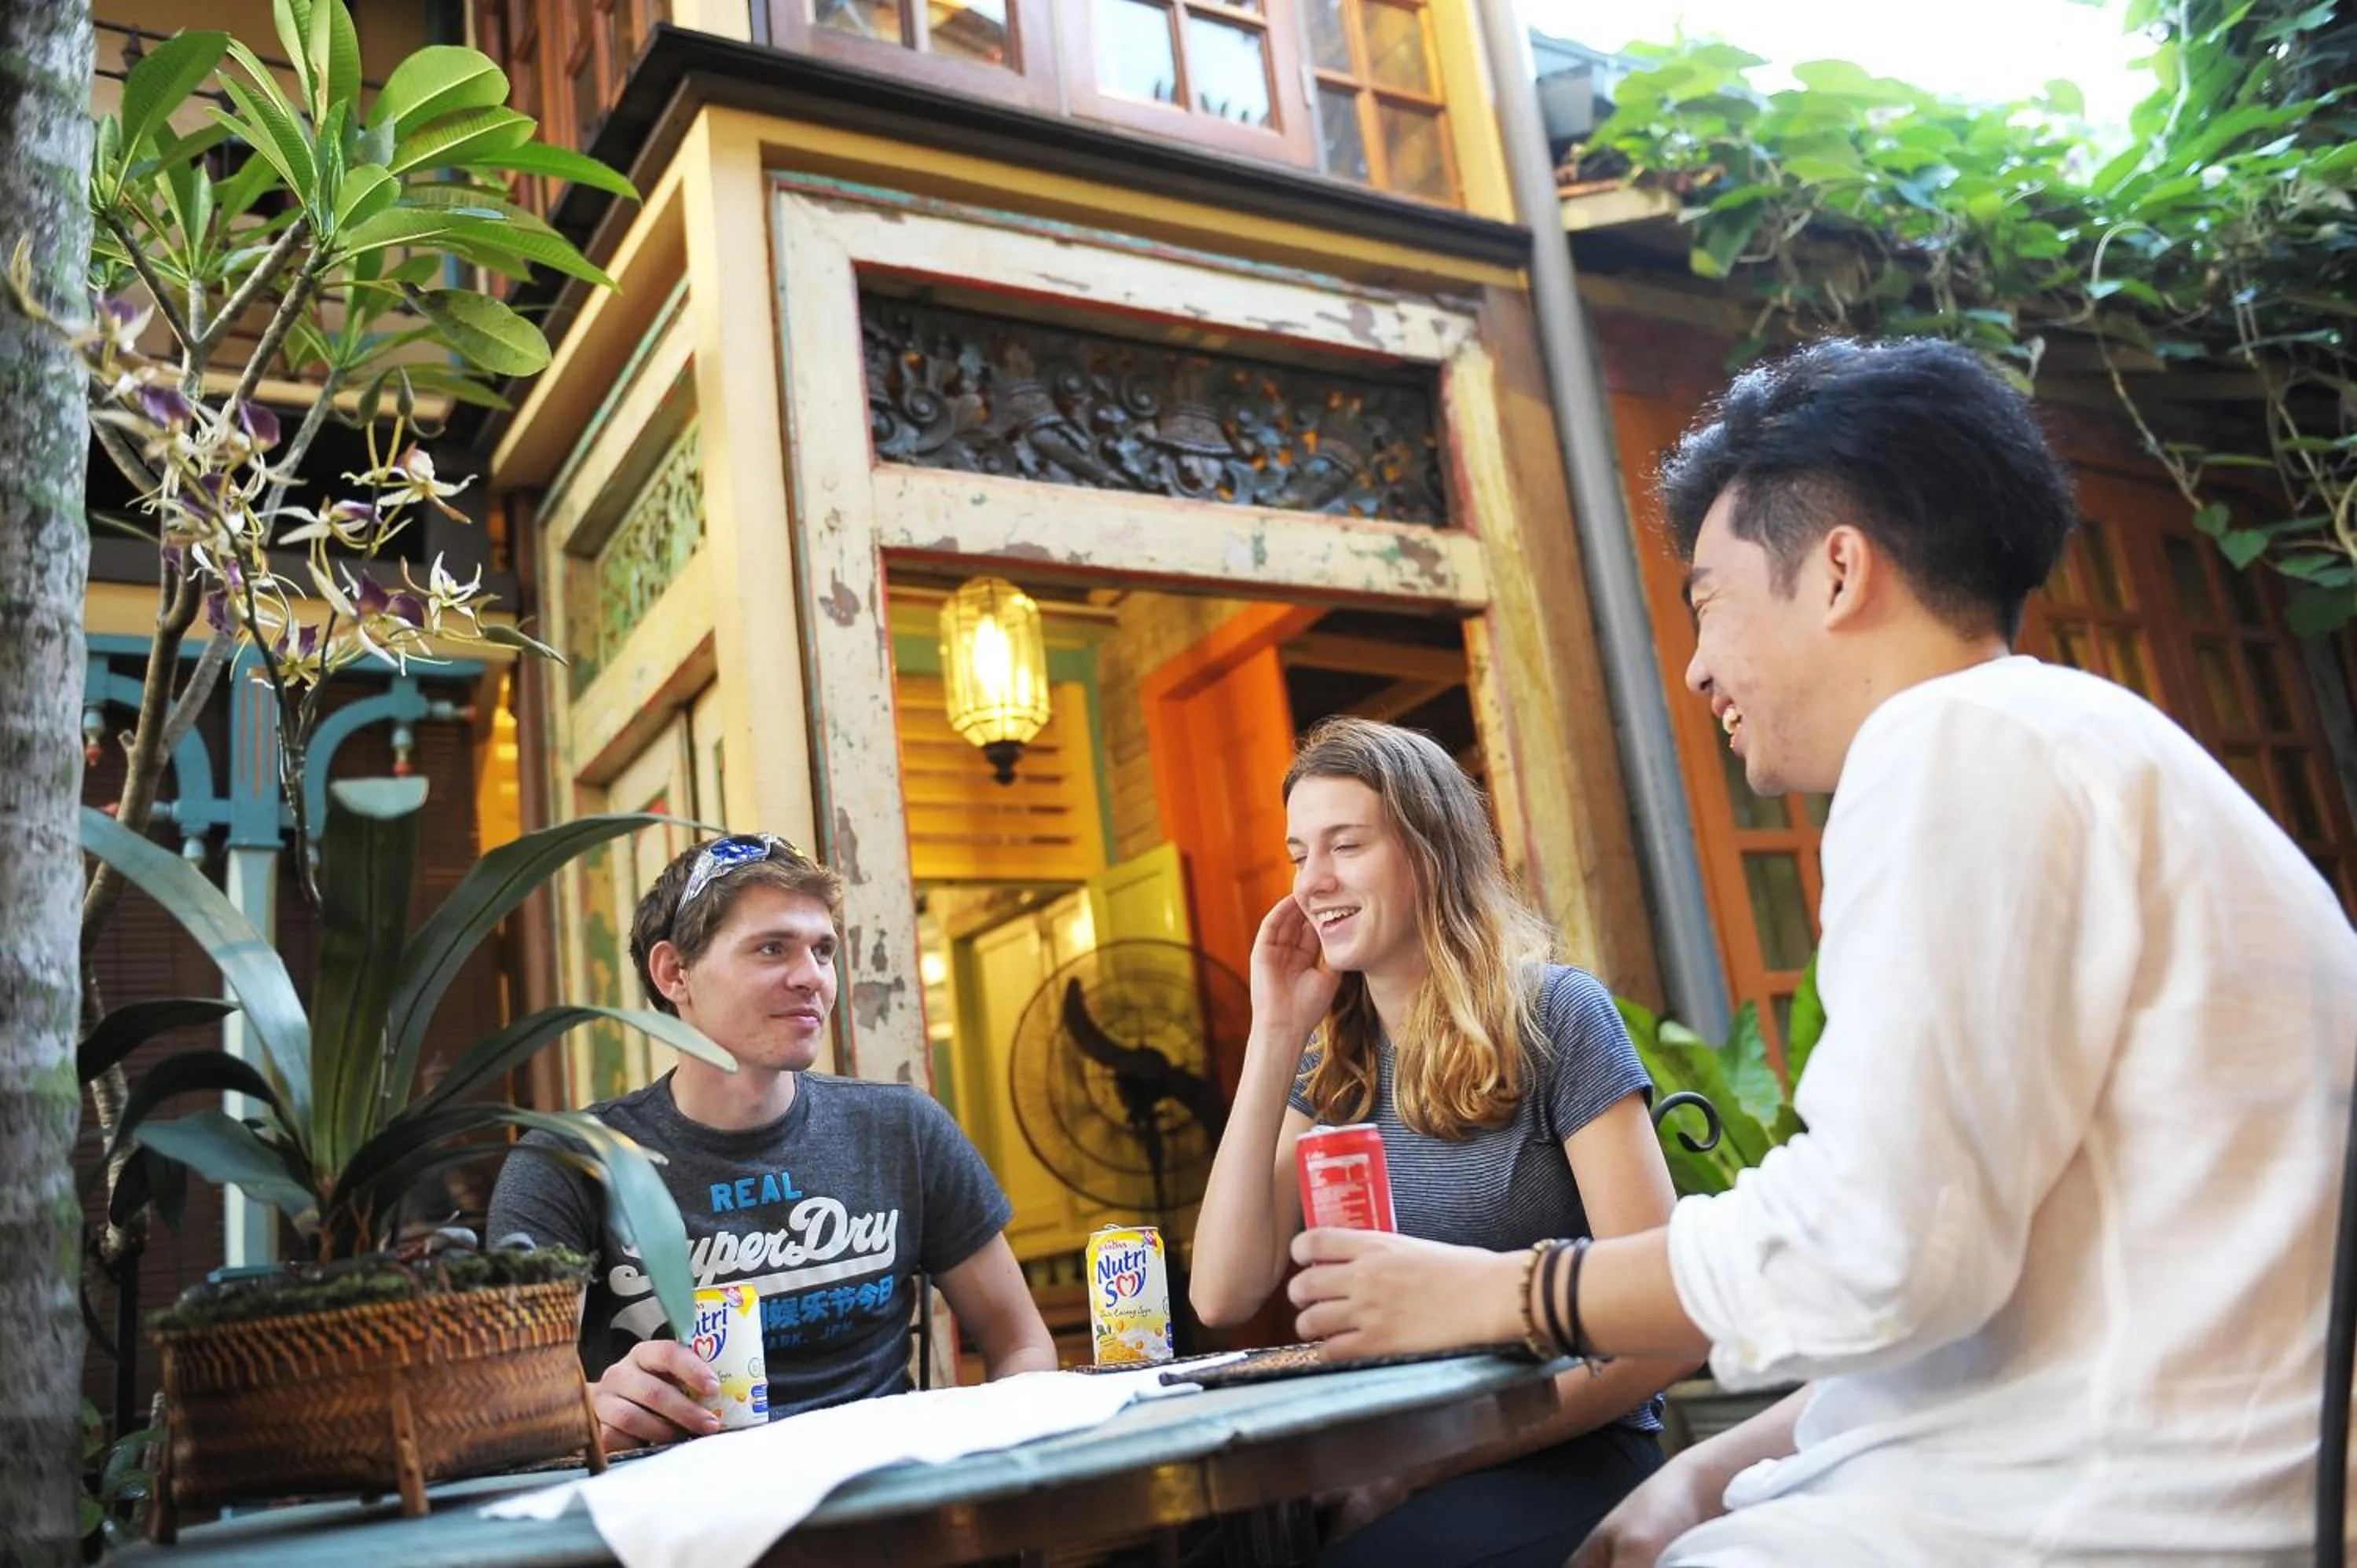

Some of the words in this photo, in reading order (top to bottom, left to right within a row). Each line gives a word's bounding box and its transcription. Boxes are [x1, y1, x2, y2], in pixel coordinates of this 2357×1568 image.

[709, 1171, 803, 1213] REAL
[1098, 1244, 1146, 1284] Nutri
[691, 1302, 728, 1338] utri
